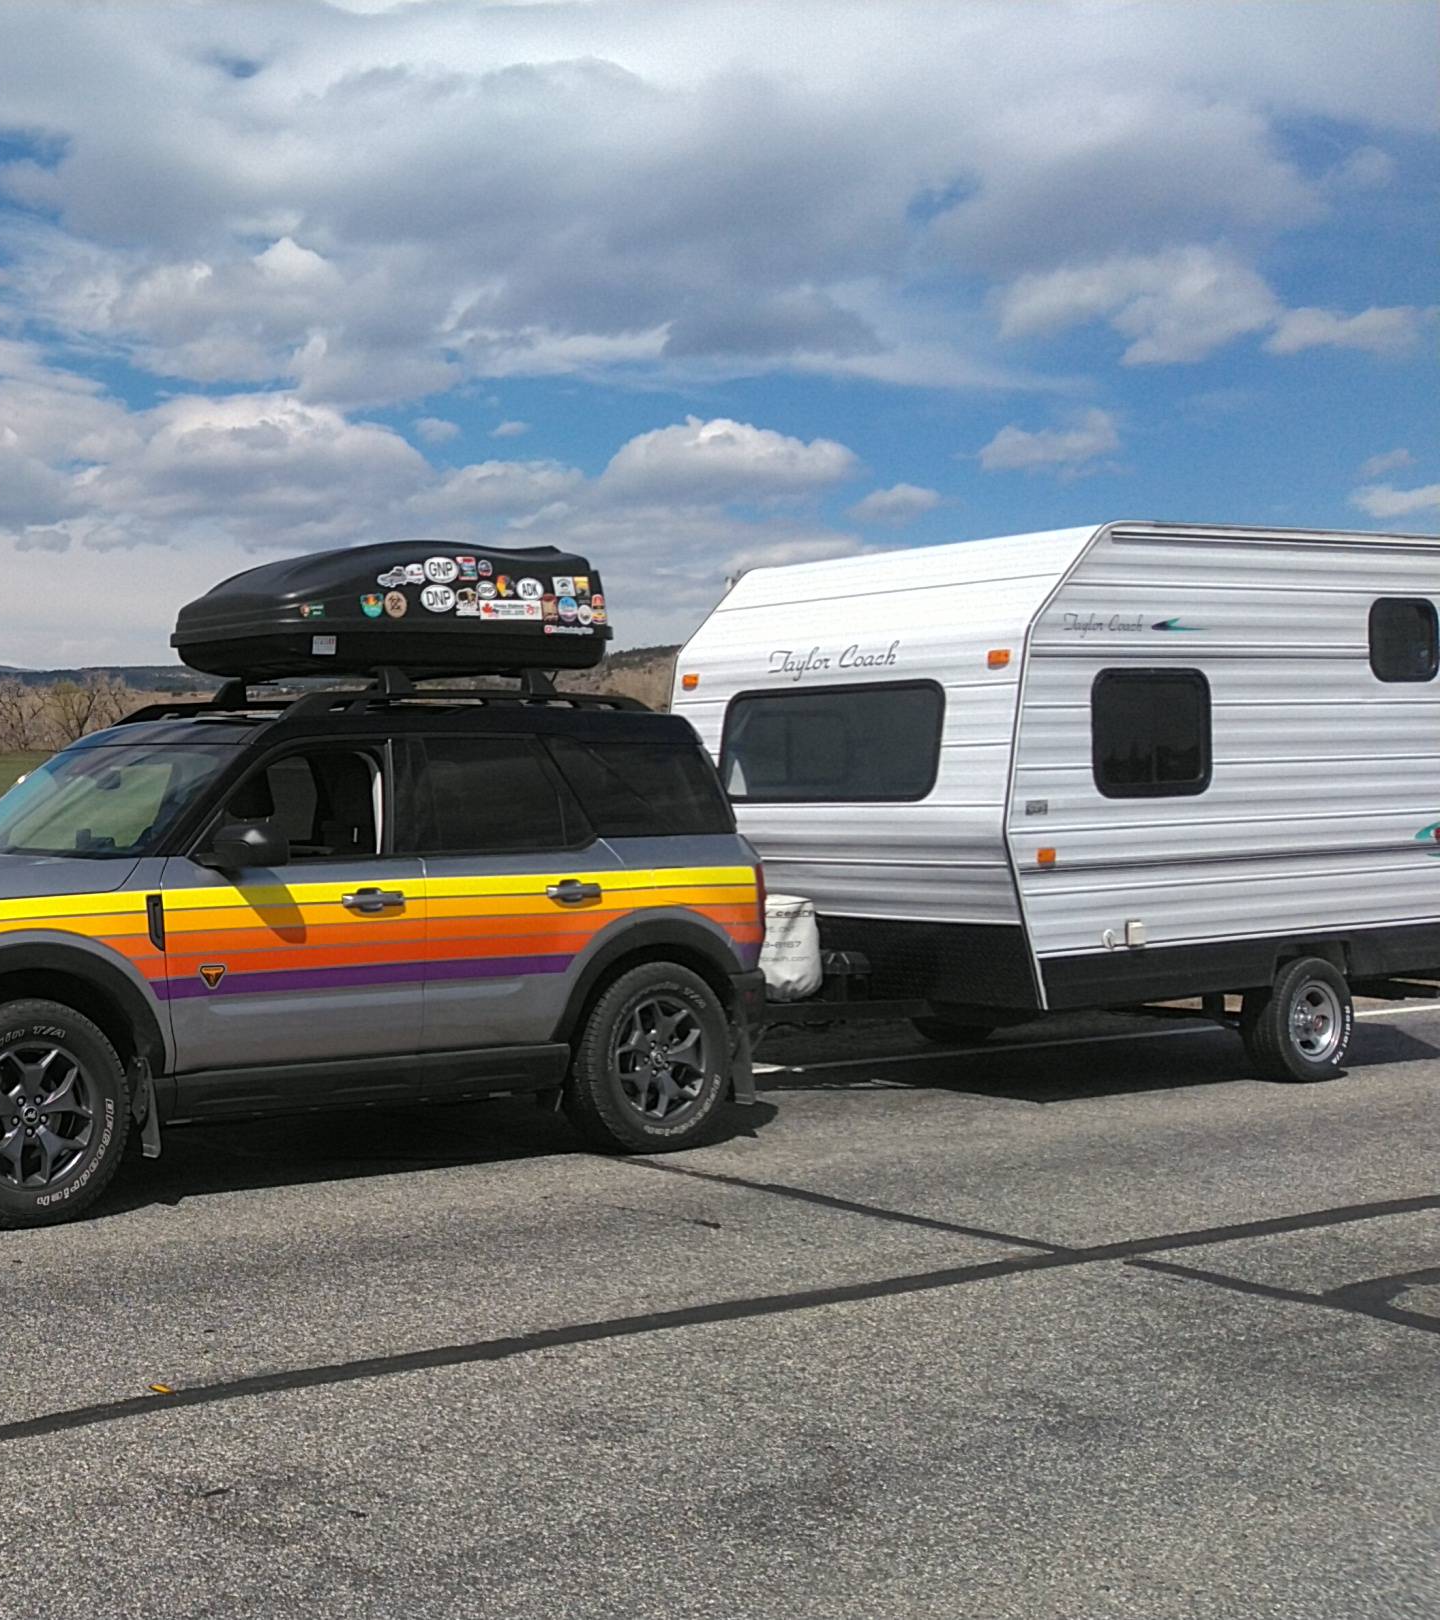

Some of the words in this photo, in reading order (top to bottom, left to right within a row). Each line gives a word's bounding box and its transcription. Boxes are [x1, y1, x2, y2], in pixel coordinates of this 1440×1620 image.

[429, 562, 452, 576] GNP
[522, 583, 538, 596] ADK
[427, 591, 450, 606] DNP
[1063, 613, 1103, 638] Taylor
[1108, 614, 1144, 632] Coach
[768, 646, 831, 681] Taylor
[839, 640, 900, 668] Coach
